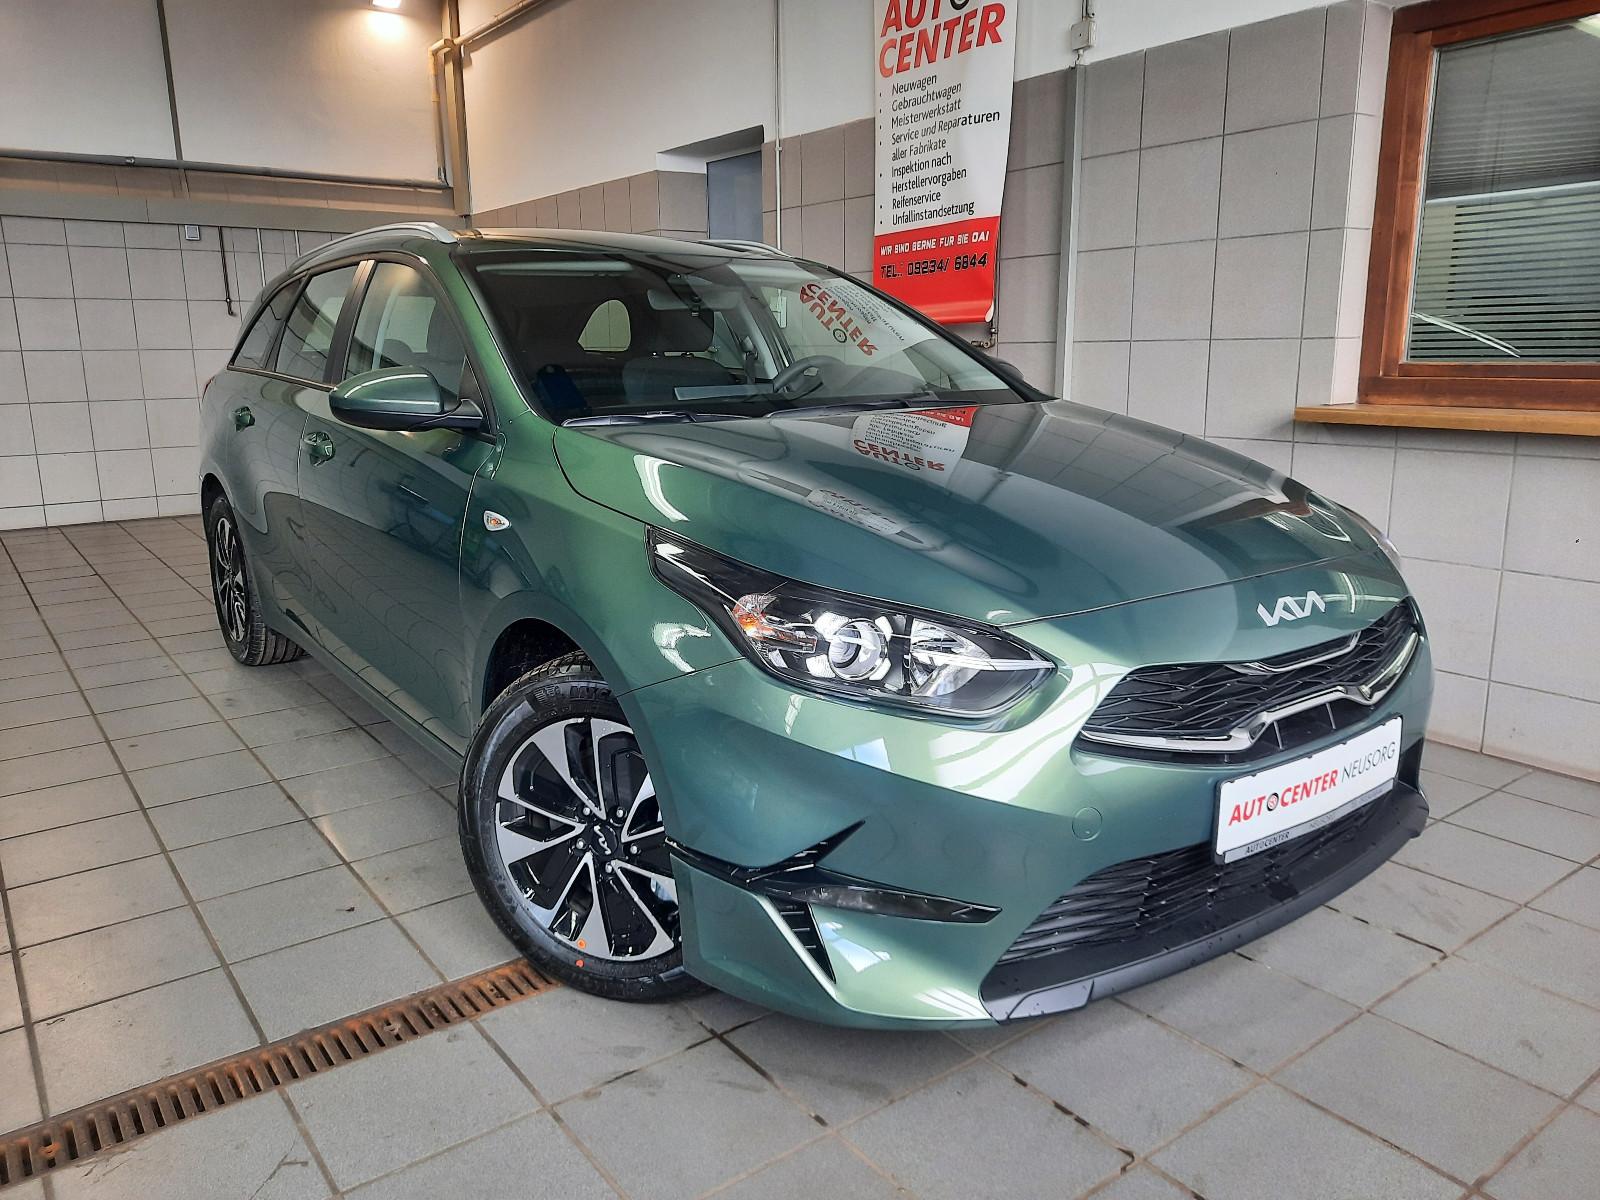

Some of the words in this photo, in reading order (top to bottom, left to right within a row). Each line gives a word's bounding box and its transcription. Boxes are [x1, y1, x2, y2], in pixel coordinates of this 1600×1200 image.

[879, 3, 1005, 78] CENTER
[892, 75, 937, 96] Neuwagen
[892, 83, 962, 112] Gebrauchtwagen
[892, 98, 962, 129] Meisterwerkstatt
[891, 128, 919, 145] Service
[921, 121, 937, 136] und
[938, 111, 1000, 134] Reparaturen
[891, 148, 907, 161] aller
[909, 138, 946, 157] Fabrikate
[891, 159, 929, 179] Inspektion
[931, 152, 952, 168] nach
[891, 168, 967, 194] Herstellervorgaben
[892, 190, 941, 210] Reifenservice
[892, 201, 975, 226] Unfallinstandsetzung
[880, 245, 892, 256] WIR
[957, 233, 969, 245] SIE
[954, 252, 989, 271] 6844
[1257, 590, 1325, 627] KIA
[1228, 769, 1339, 827] AUTOCENTER
[1341, 741, 1396, 784] NEUSORG
